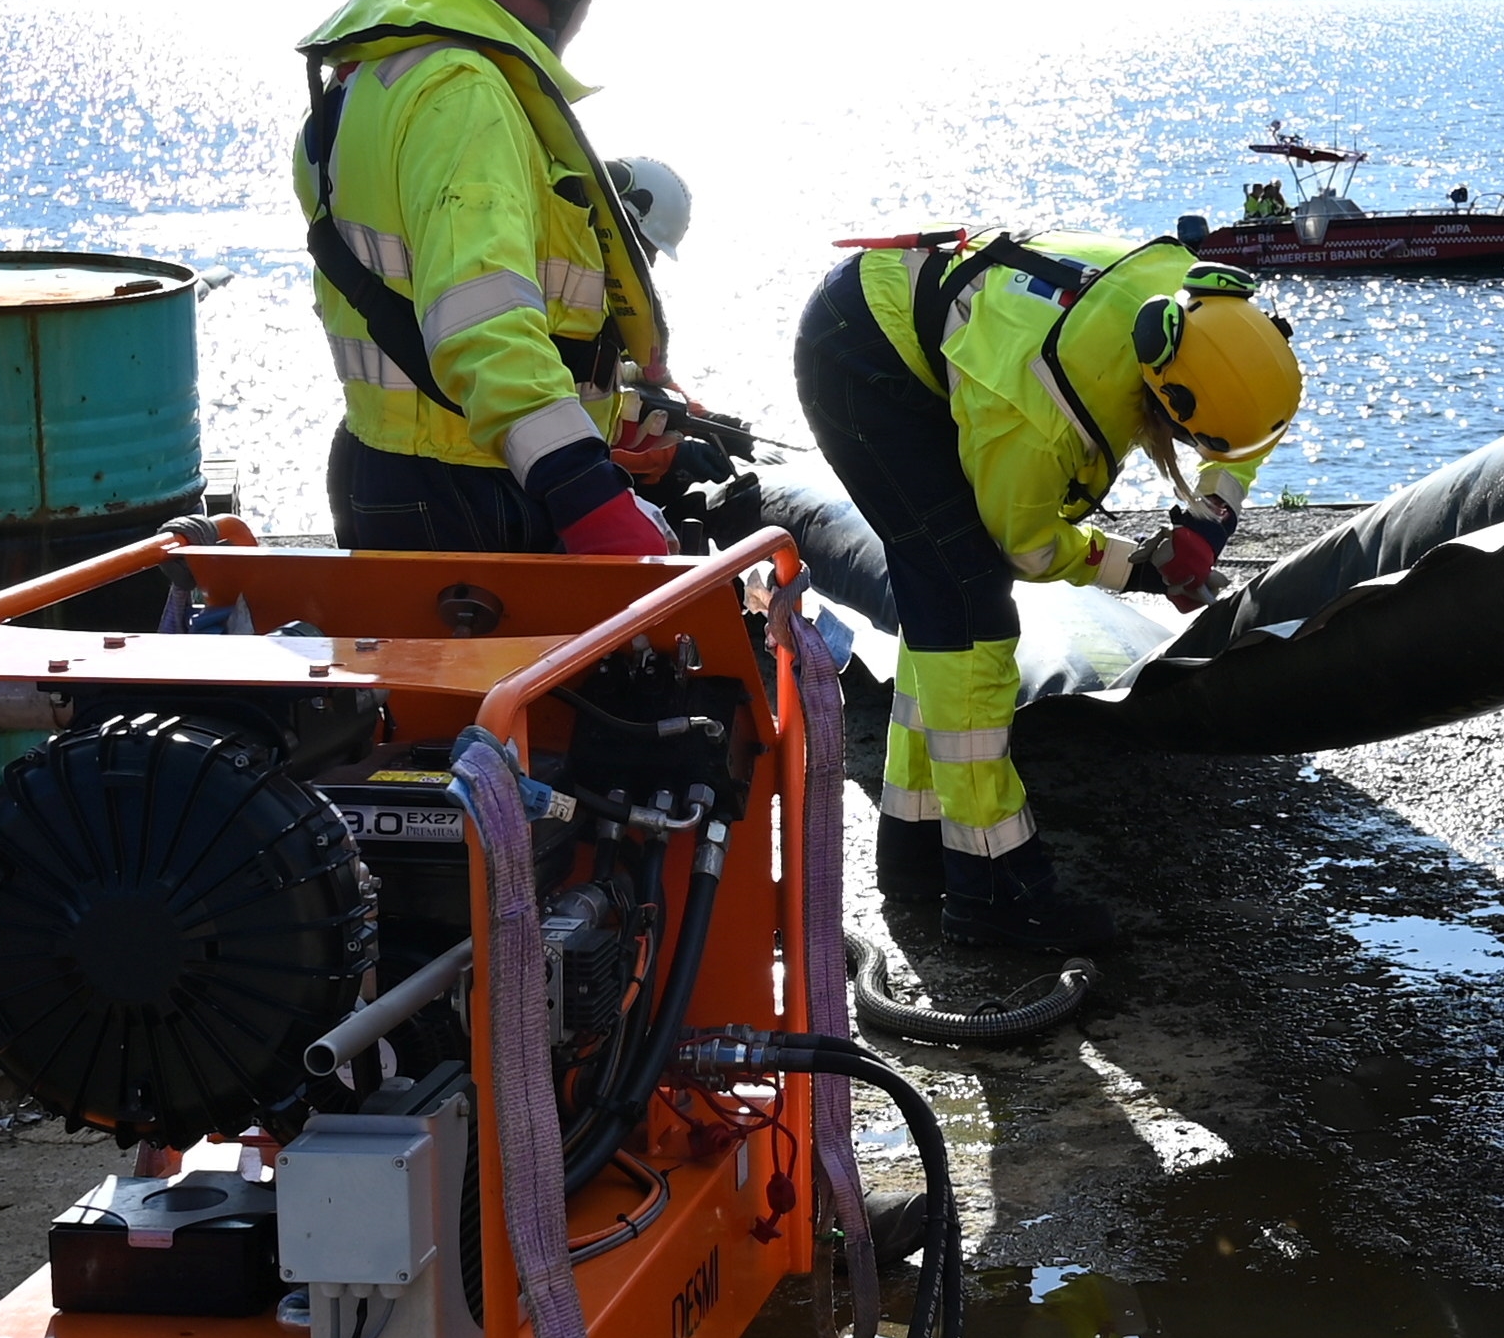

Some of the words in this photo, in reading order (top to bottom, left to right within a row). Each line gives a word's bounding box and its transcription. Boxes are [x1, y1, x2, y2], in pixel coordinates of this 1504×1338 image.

[1431, 224, 1471, 235] JOMPA
[1256, 251, 1329, 265] HAMMERFEST
[1329, 249, 1367, 261] BRANN
[406, 812, 459, 825] EX27
[405, 825, 461, 838] PREMIUM
